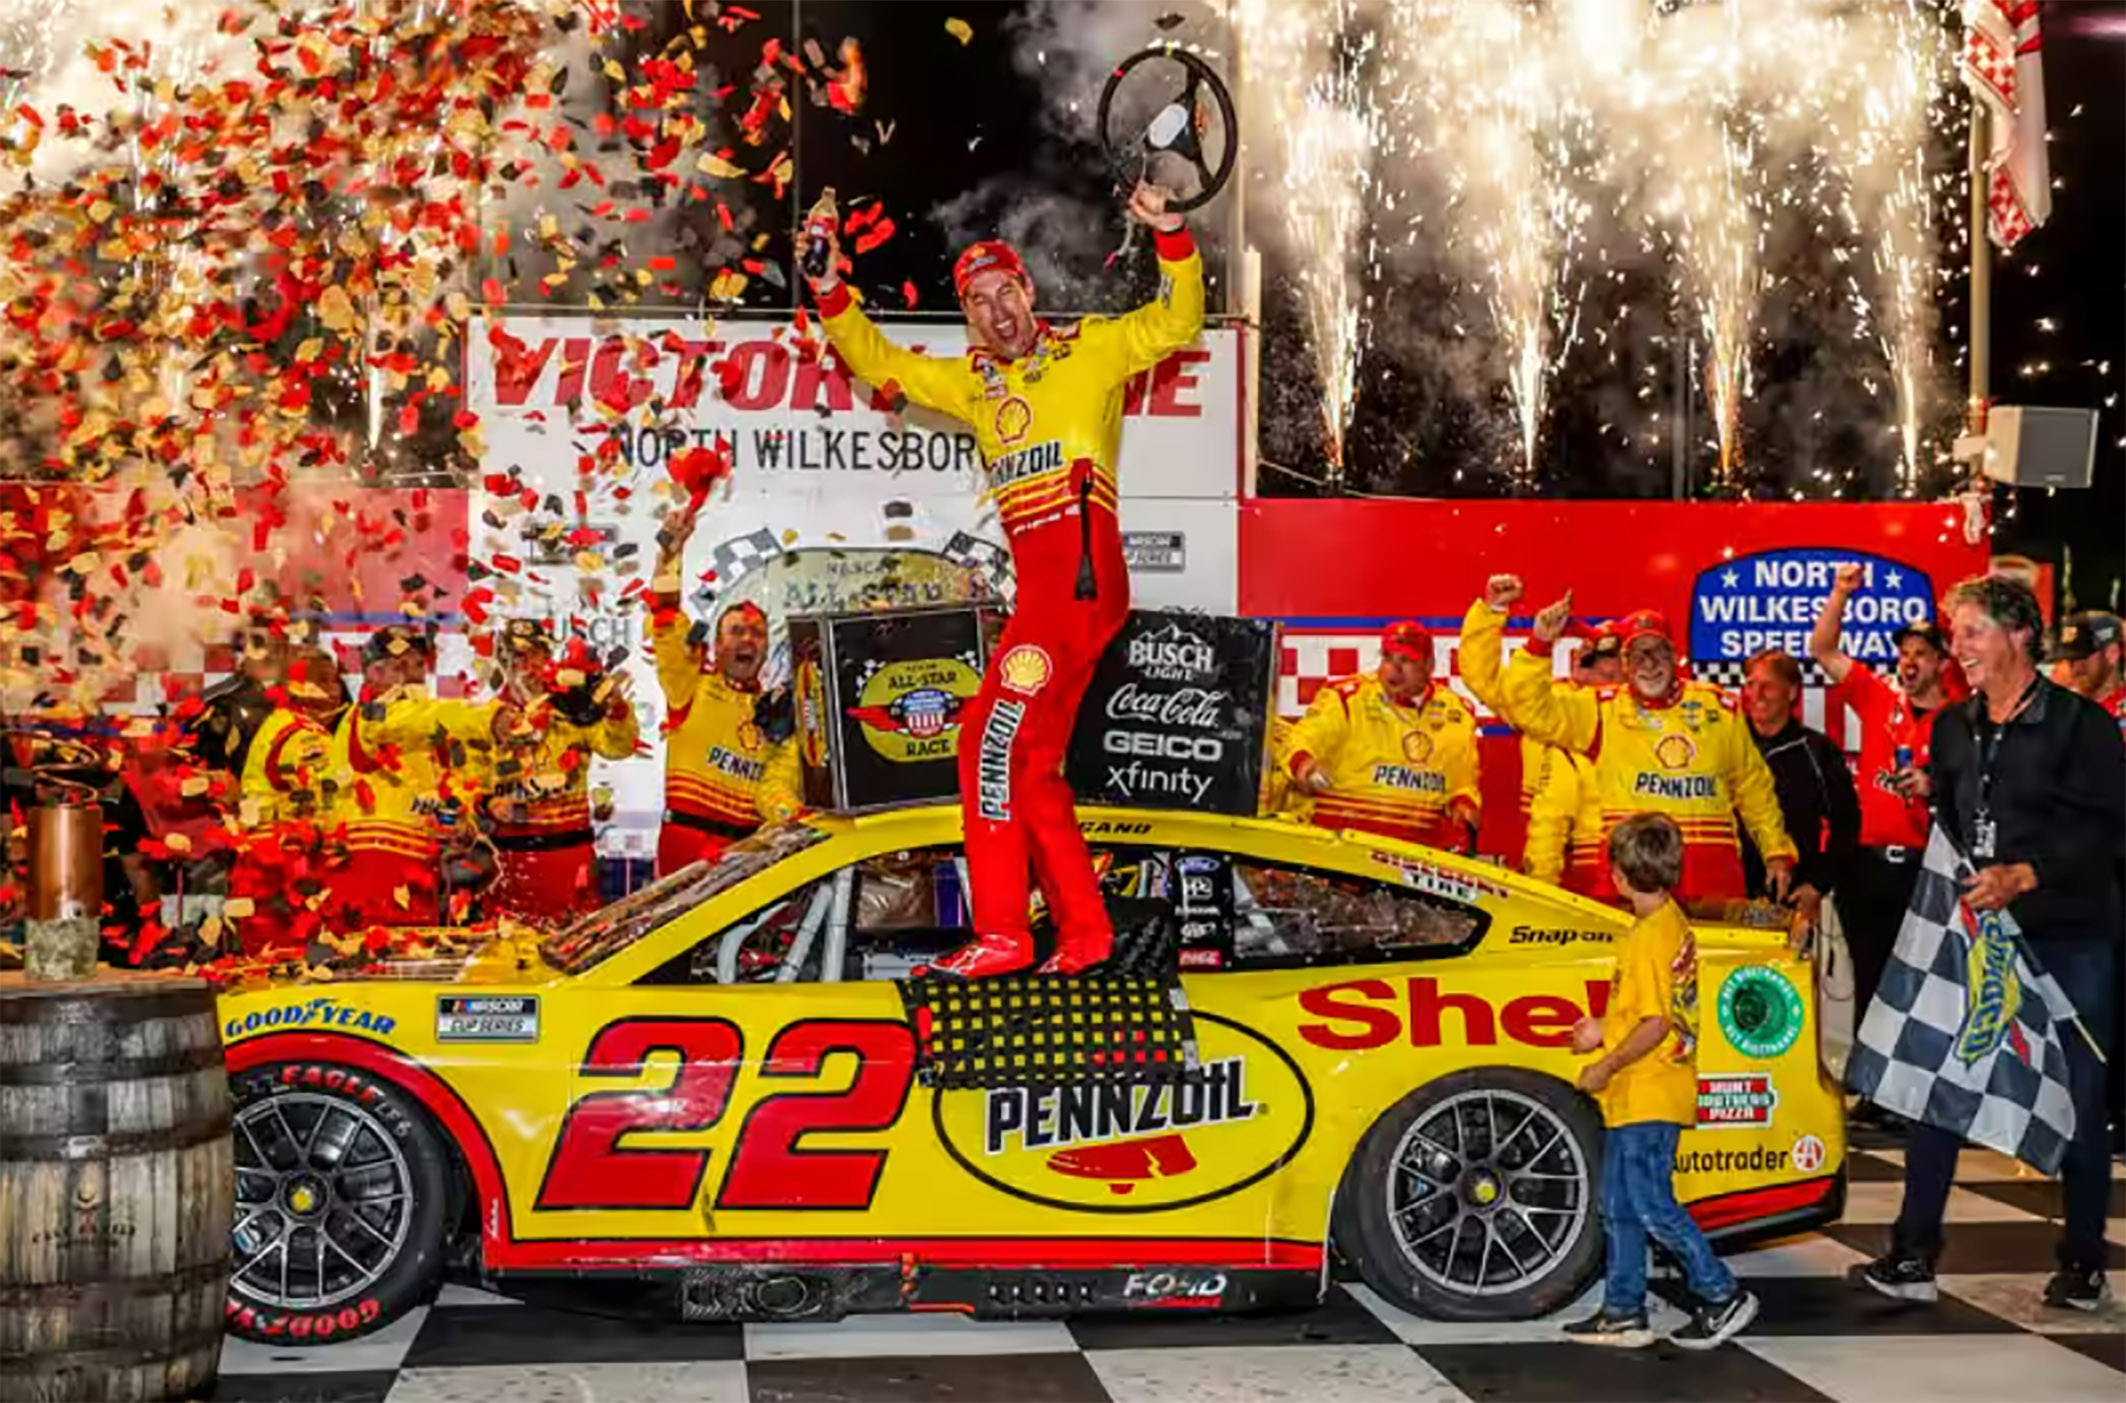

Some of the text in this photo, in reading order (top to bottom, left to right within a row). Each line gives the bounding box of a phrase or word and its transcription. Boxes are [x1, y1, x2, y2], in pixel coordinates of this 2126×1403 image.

[495, 337, 892, 412] VICTOR
[755, 429, 991, 473] WILKESBOR
[1129, 640, 1213, 673] BUSCH
[1143, 665, 1195, 681] LIGHT
[1105, 682, 1224, 728] Coca-Cola
[708, 747, 766, 783] PENNZ
[906, 739, 952, 756] RACE
[979, 698, 1026, 820] PENNZOIL
[1103, 730, 1223, 762] GEICO
[1105, 760, 1213, 803] xfinity
[1635, 771, 1718, 798] PENNZOIL
[1410, 871, 1472, 900] TIRE
[1508, 925, 1614, 946] Snap-on
[225, 999, 396, 1038] GOODYEAR
[1298, 976, 1612, 1050] Shel
[281, 1064, 387, 1108] EAGLE
[987, 1057, 1257, 1154] PENNZOIL
[534, 1014, 918, 1211] 22
[1708, 1108, 1755, 1120] PIZZA
